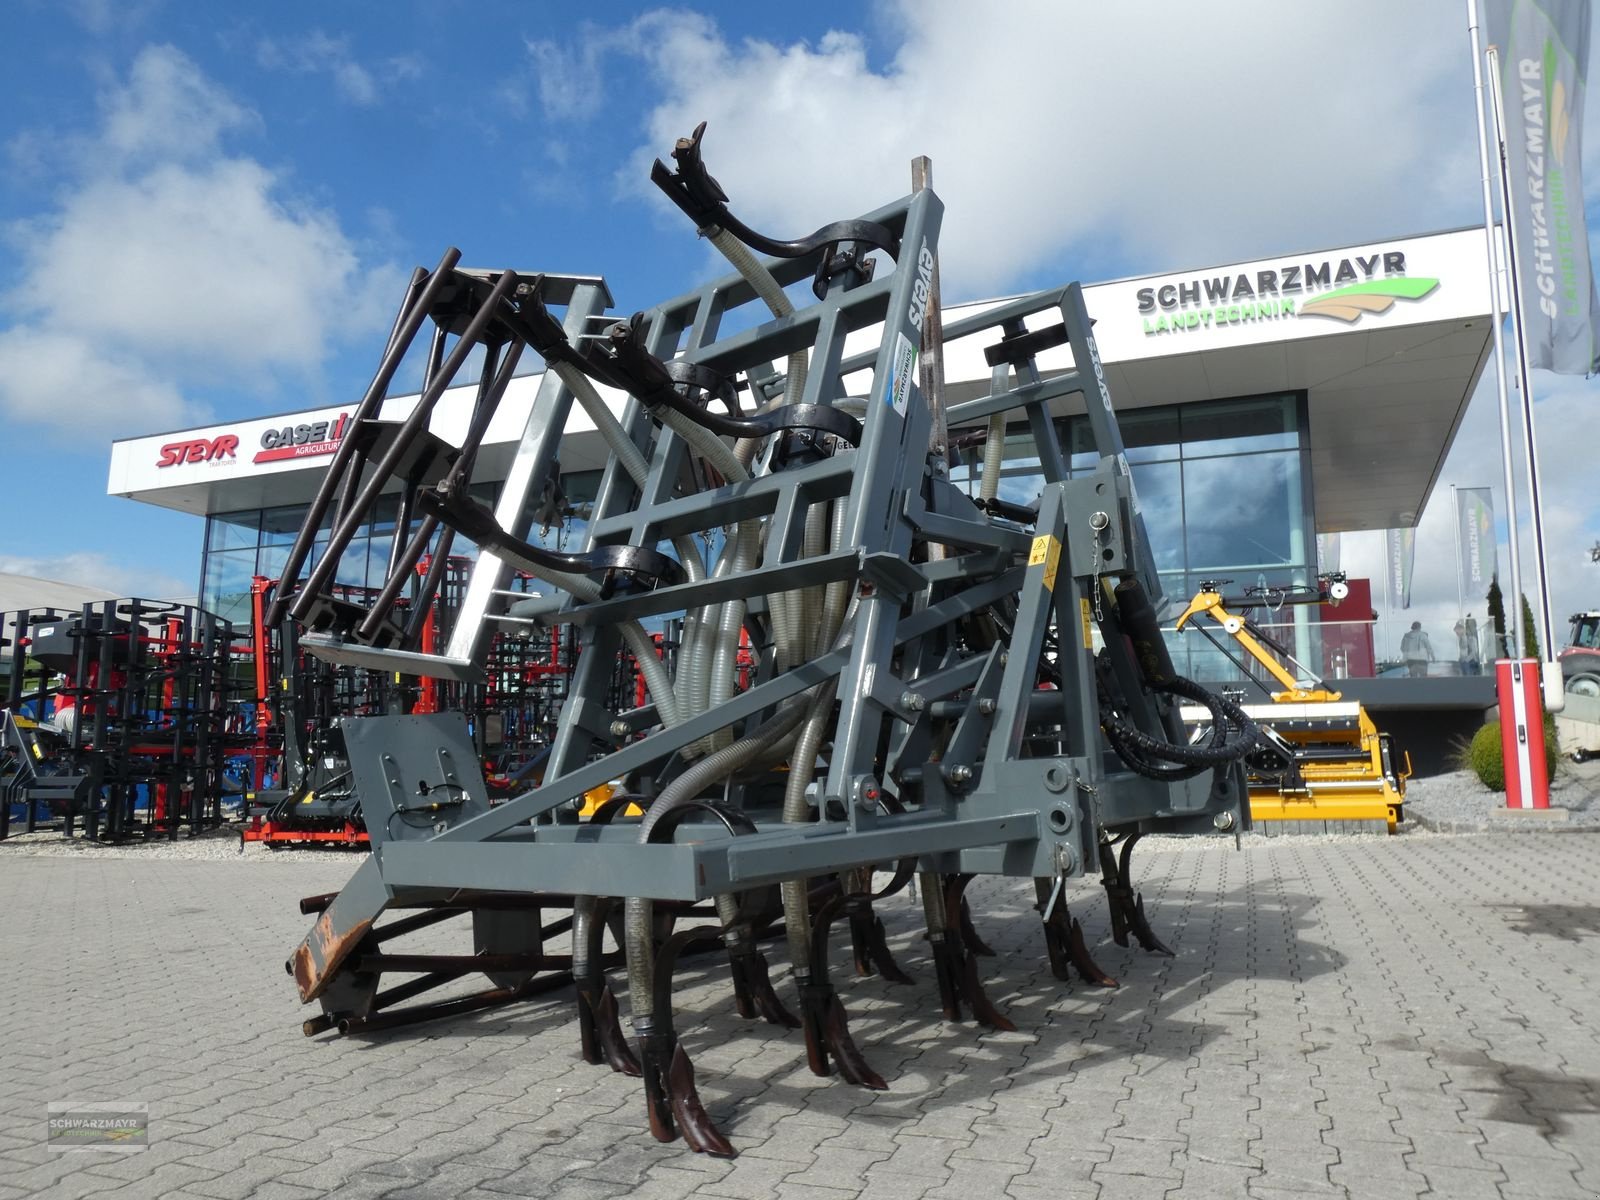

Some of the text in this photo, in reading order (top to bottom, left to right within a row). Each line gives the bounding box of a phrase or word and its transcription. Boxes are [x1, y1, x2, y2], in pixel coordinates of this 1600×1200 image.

[1518, 57, 1557, 320] SCHWARZMAYR
[1136, 250, 1407, 312] SCHWARZMAYR
[1143, 297, 1297, 336] LANDTECHNIK
[898, 348, 912, 403] SCHWARZMAYR
[156, 434, 239, 468] STEYR
[260, 421, 329, 450] CASE
[1468, 508, 1481, 583] SCHWARZMAYR
